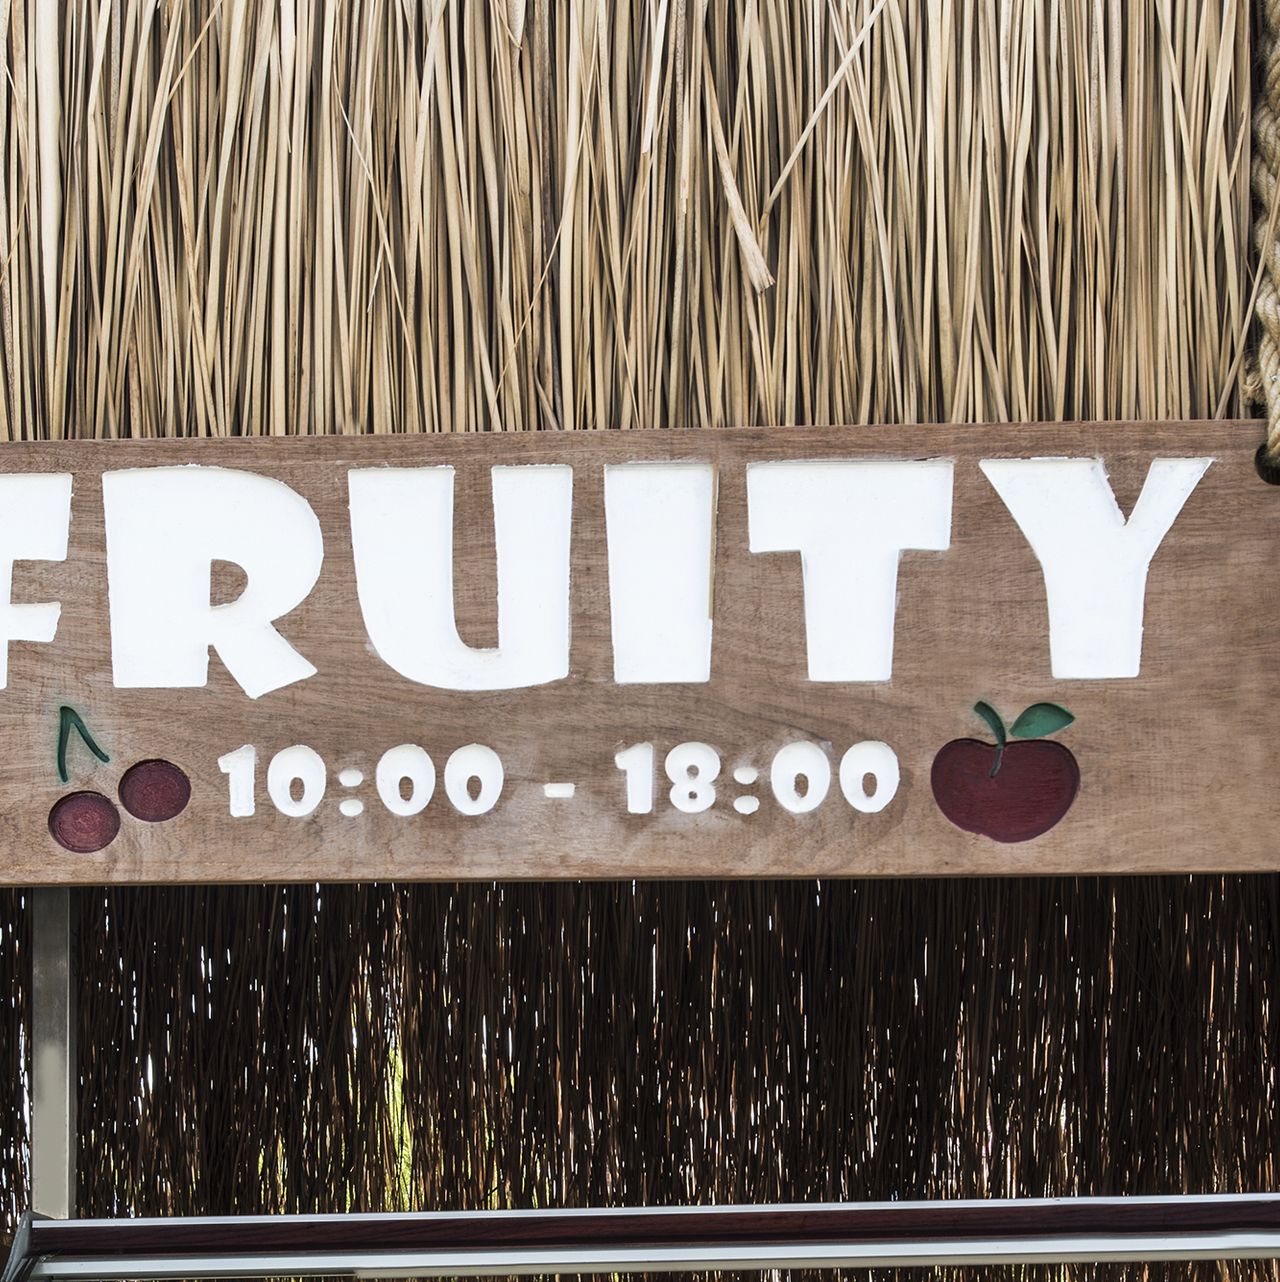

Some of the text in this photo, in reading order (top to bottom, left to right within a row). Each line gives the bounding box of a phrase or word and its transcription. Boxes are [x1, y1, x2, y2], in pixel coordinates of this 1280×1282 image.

[216, 742, 901, 819] 10:00 - 18:00
